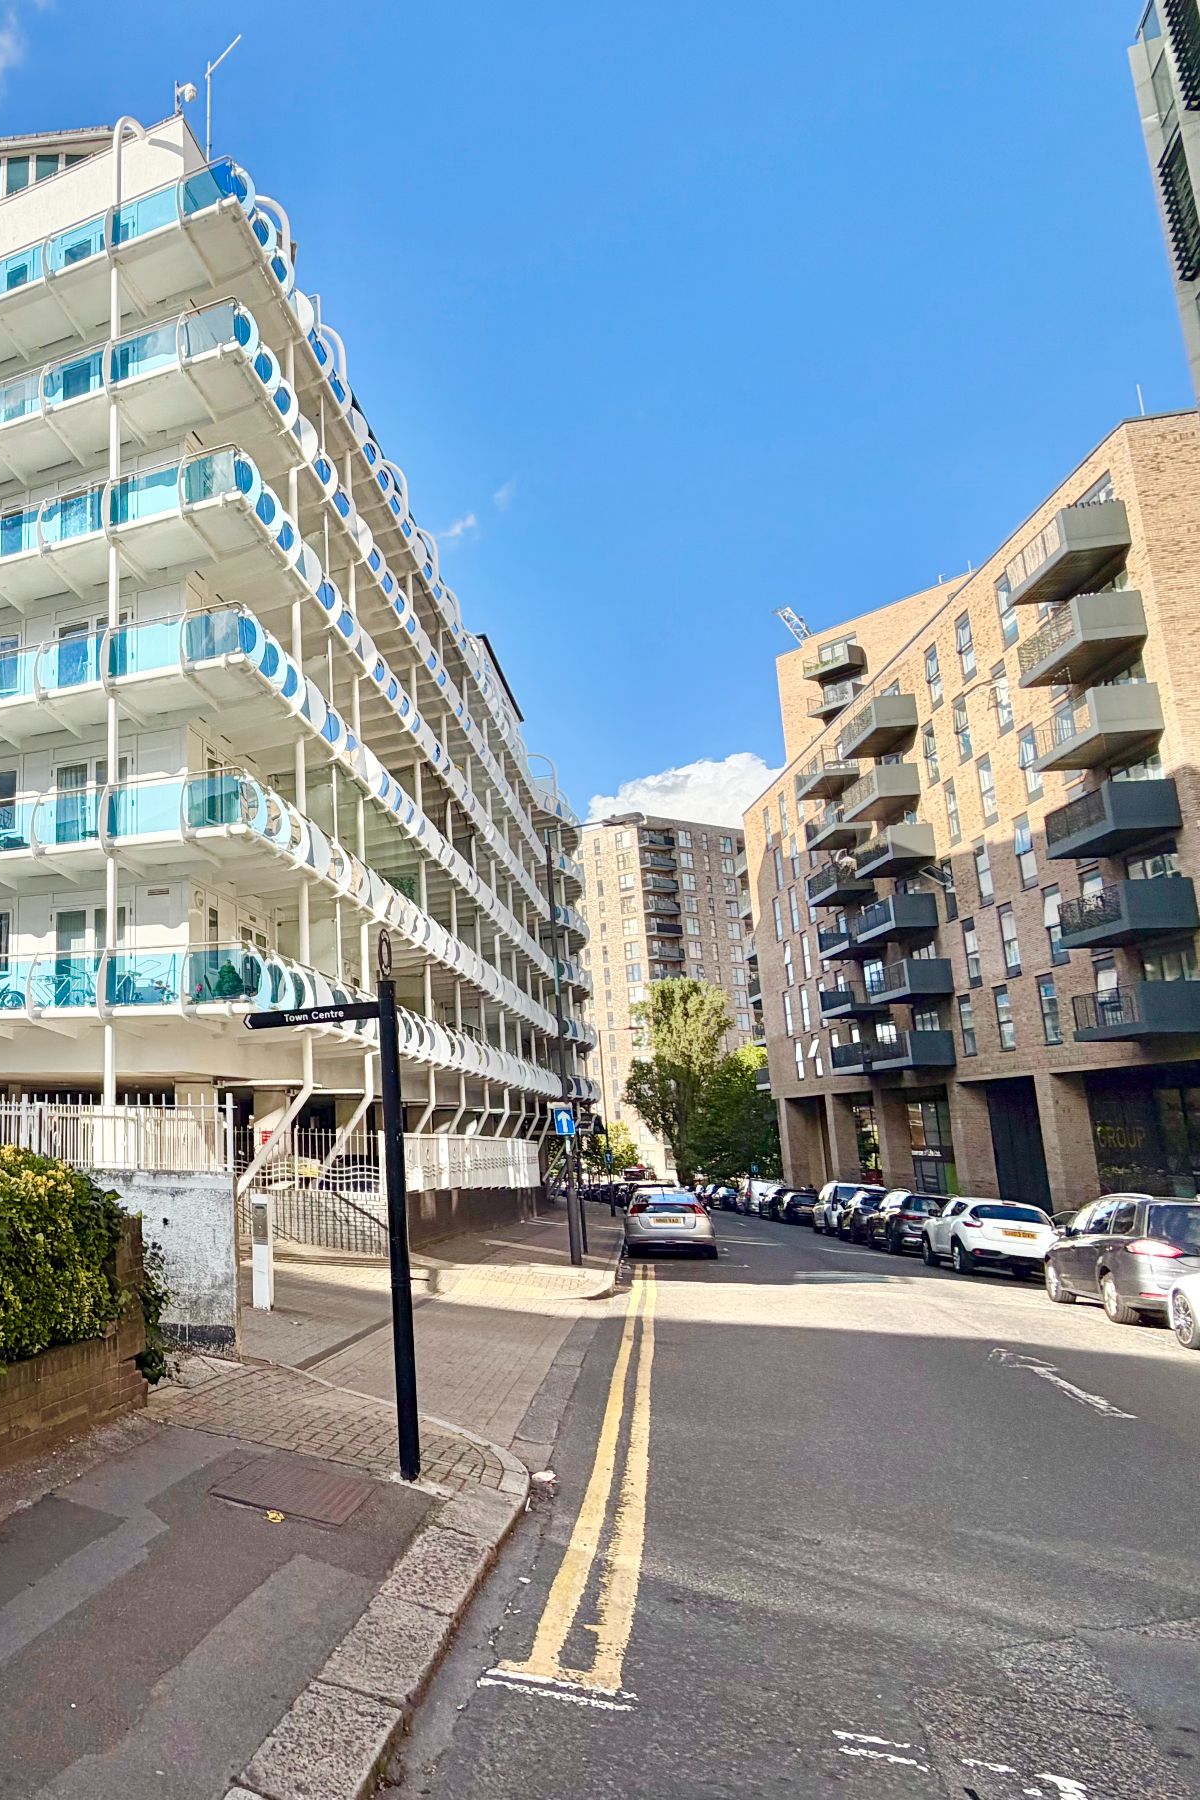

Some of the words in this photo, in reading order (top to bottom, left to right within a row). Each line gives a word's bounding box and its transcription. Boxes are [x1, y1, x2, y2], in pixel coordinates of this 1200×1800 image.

[283, 1013, 309, 1022] Town
[311, 1010, 344, 1020] Centre
[1097, 1126, 1145, 1148] GROUP
